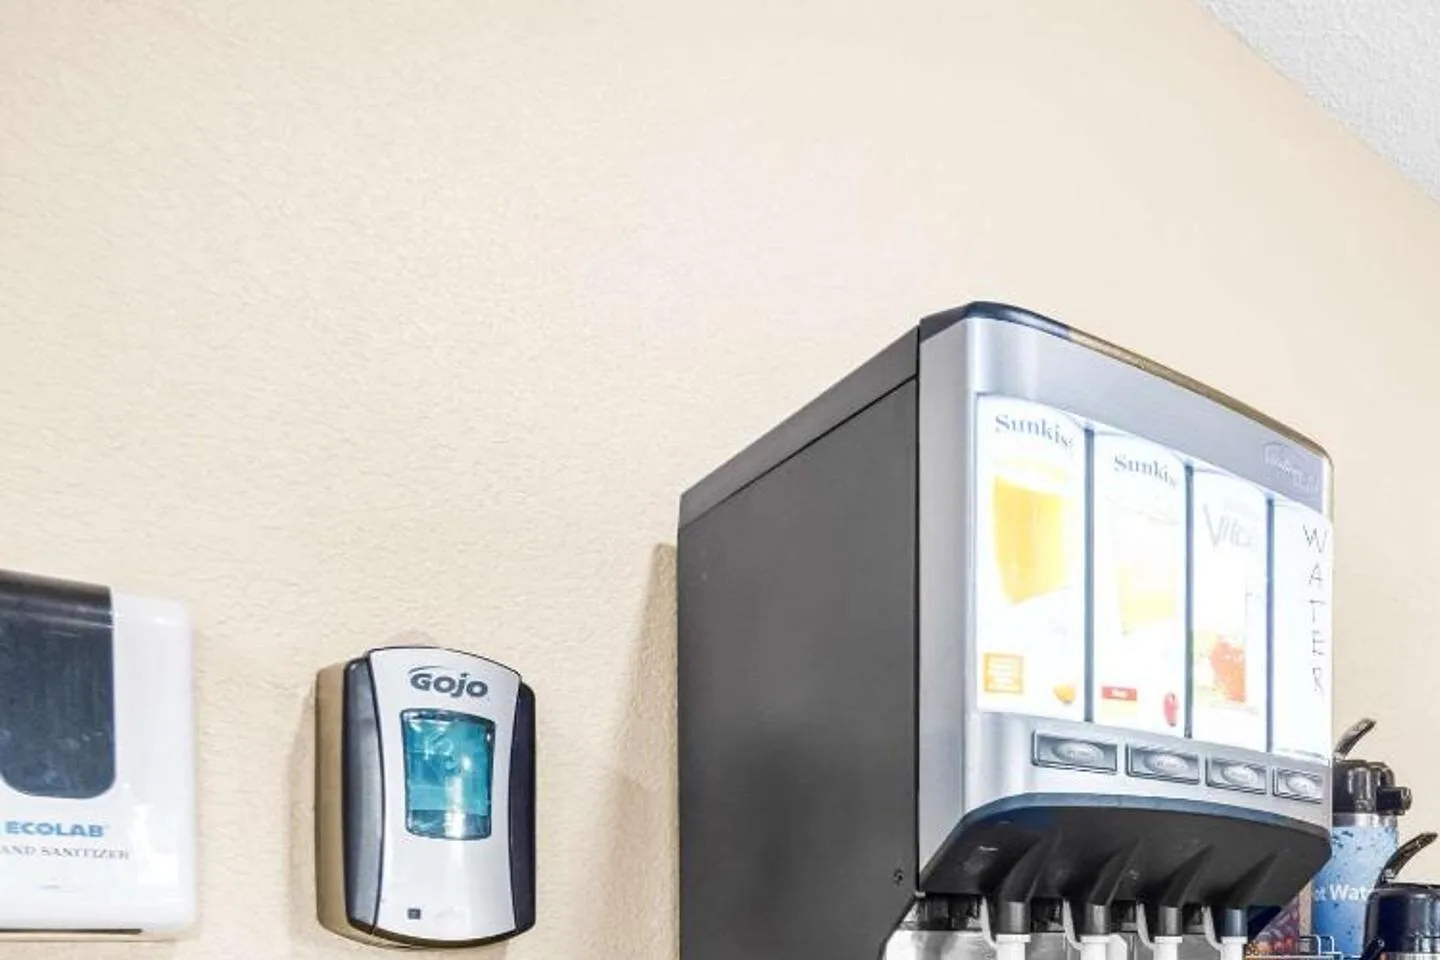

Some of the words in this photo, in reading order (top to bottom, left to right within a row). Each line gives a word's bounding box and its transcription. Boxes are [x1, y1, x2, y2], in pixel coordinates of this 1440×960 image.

[5, 821, 104, 837] ECOLAB
[0, 845, 36, 856] AND
[41, 846, 129, 860] SANITIZER
[1329, 884, 1367, 901] Wat
